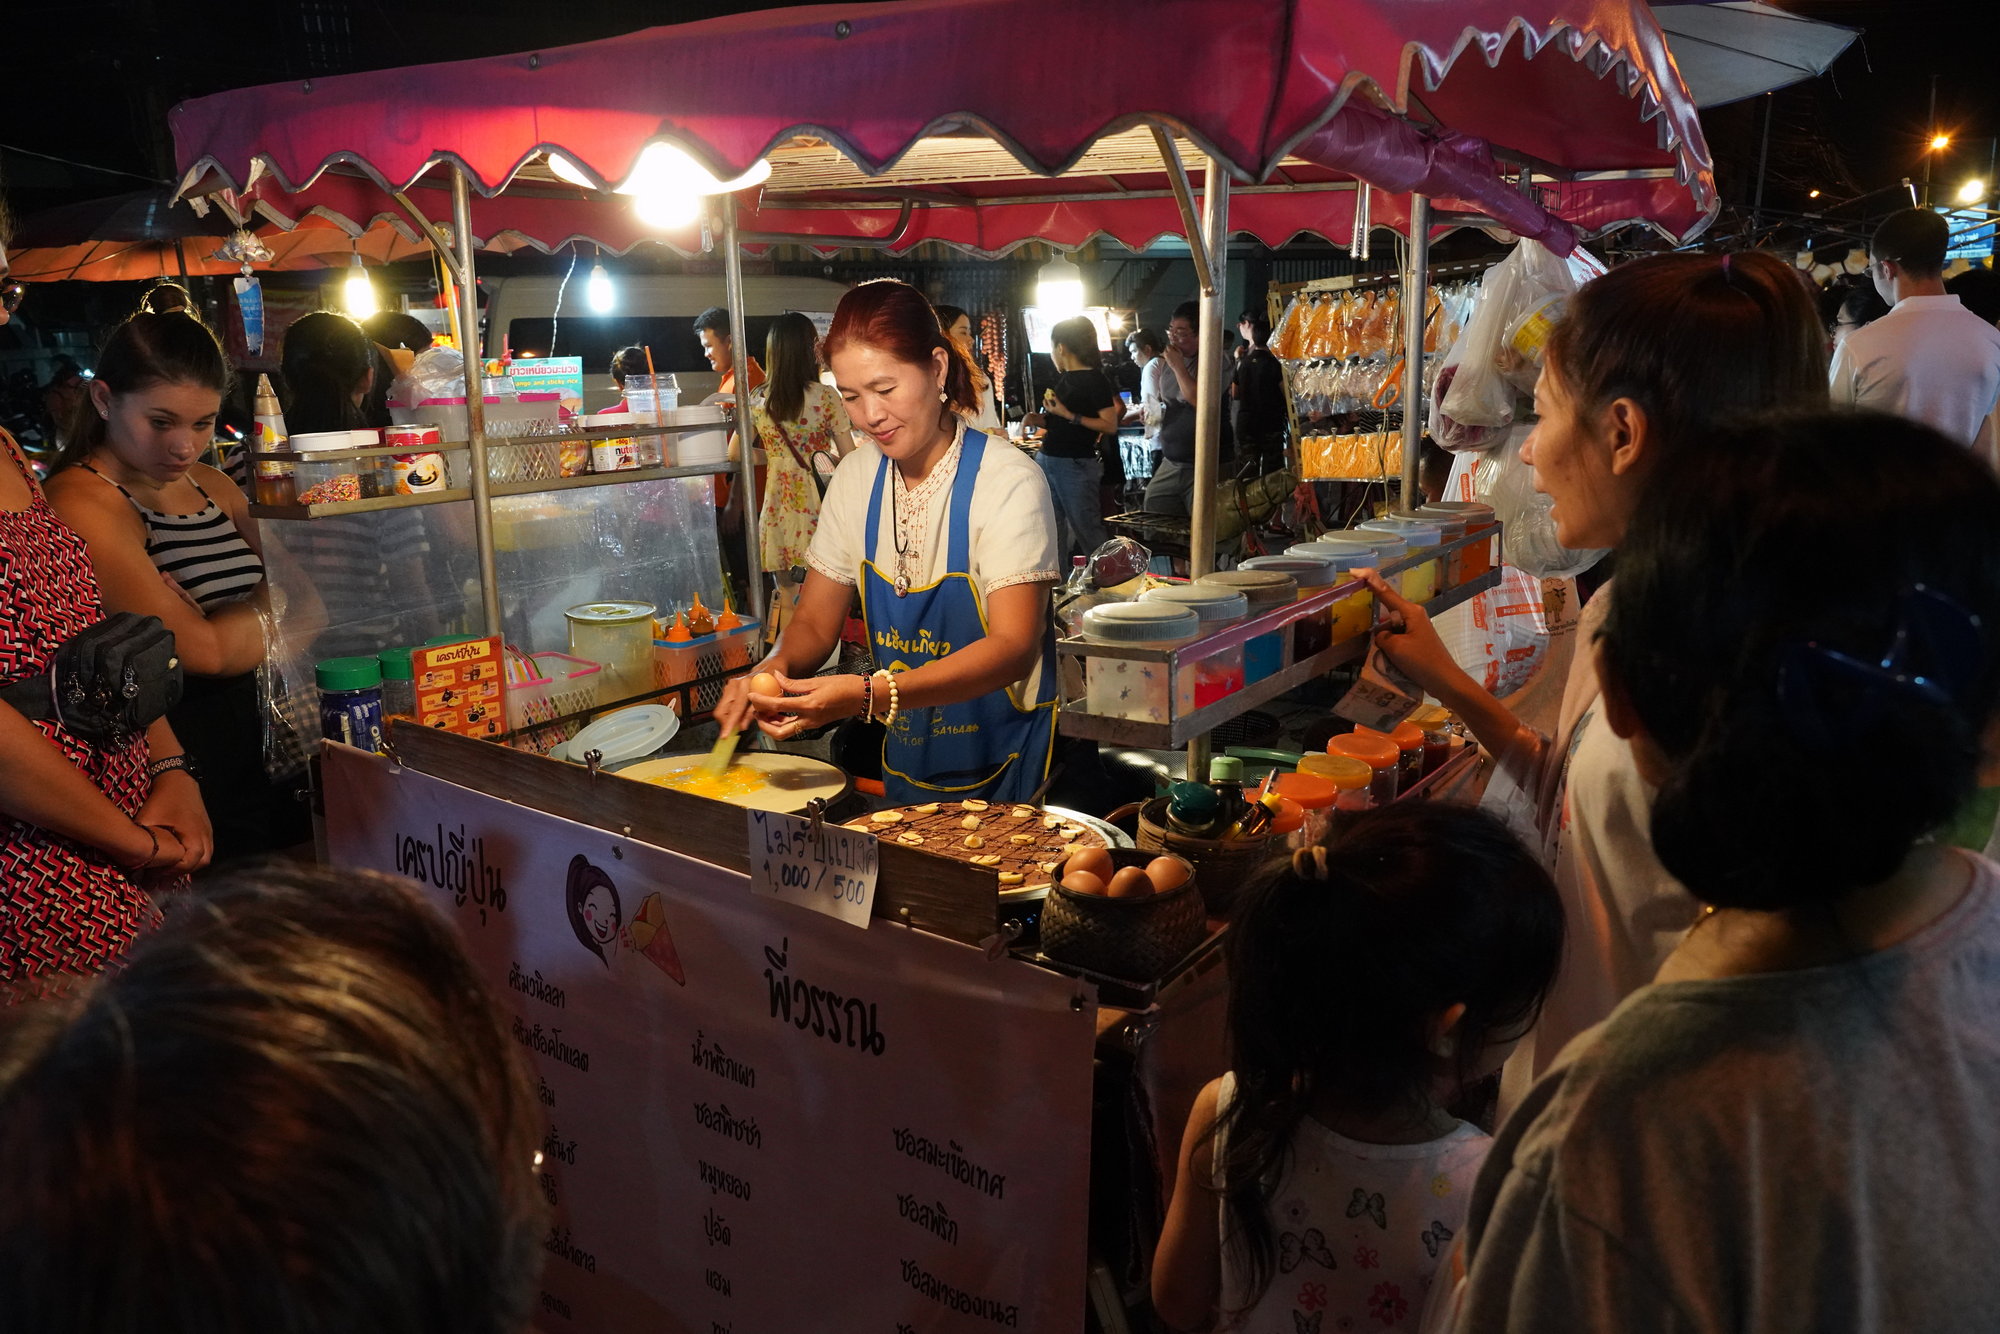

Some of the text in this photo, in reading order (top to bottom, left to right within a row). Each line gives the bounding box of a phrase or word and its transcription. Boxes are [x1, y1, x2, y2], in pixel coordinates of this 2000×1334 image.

[396, 823, 507, 927] เครปญี่ปุ่น
[764, 937, 885, 1056] พี่วรรณ
[692, 1030, 755, 1089] น้ำพริกเผา
[693, 1102, 761, 1150] ซอสพิซซ่า
[699, 1159, 751, 1201] หมูหยอง
[893, 1128, 1006, 1200] ซอสมะเขือเทศ
[704, 1207, 731, 1247] ปูอัด
[897, 1193, 958, 1246] ซอสพริก
[706, 1268, 732, 1298] แฮม
[900, 1258, 1019, 1329] ซอสมายองเนส
